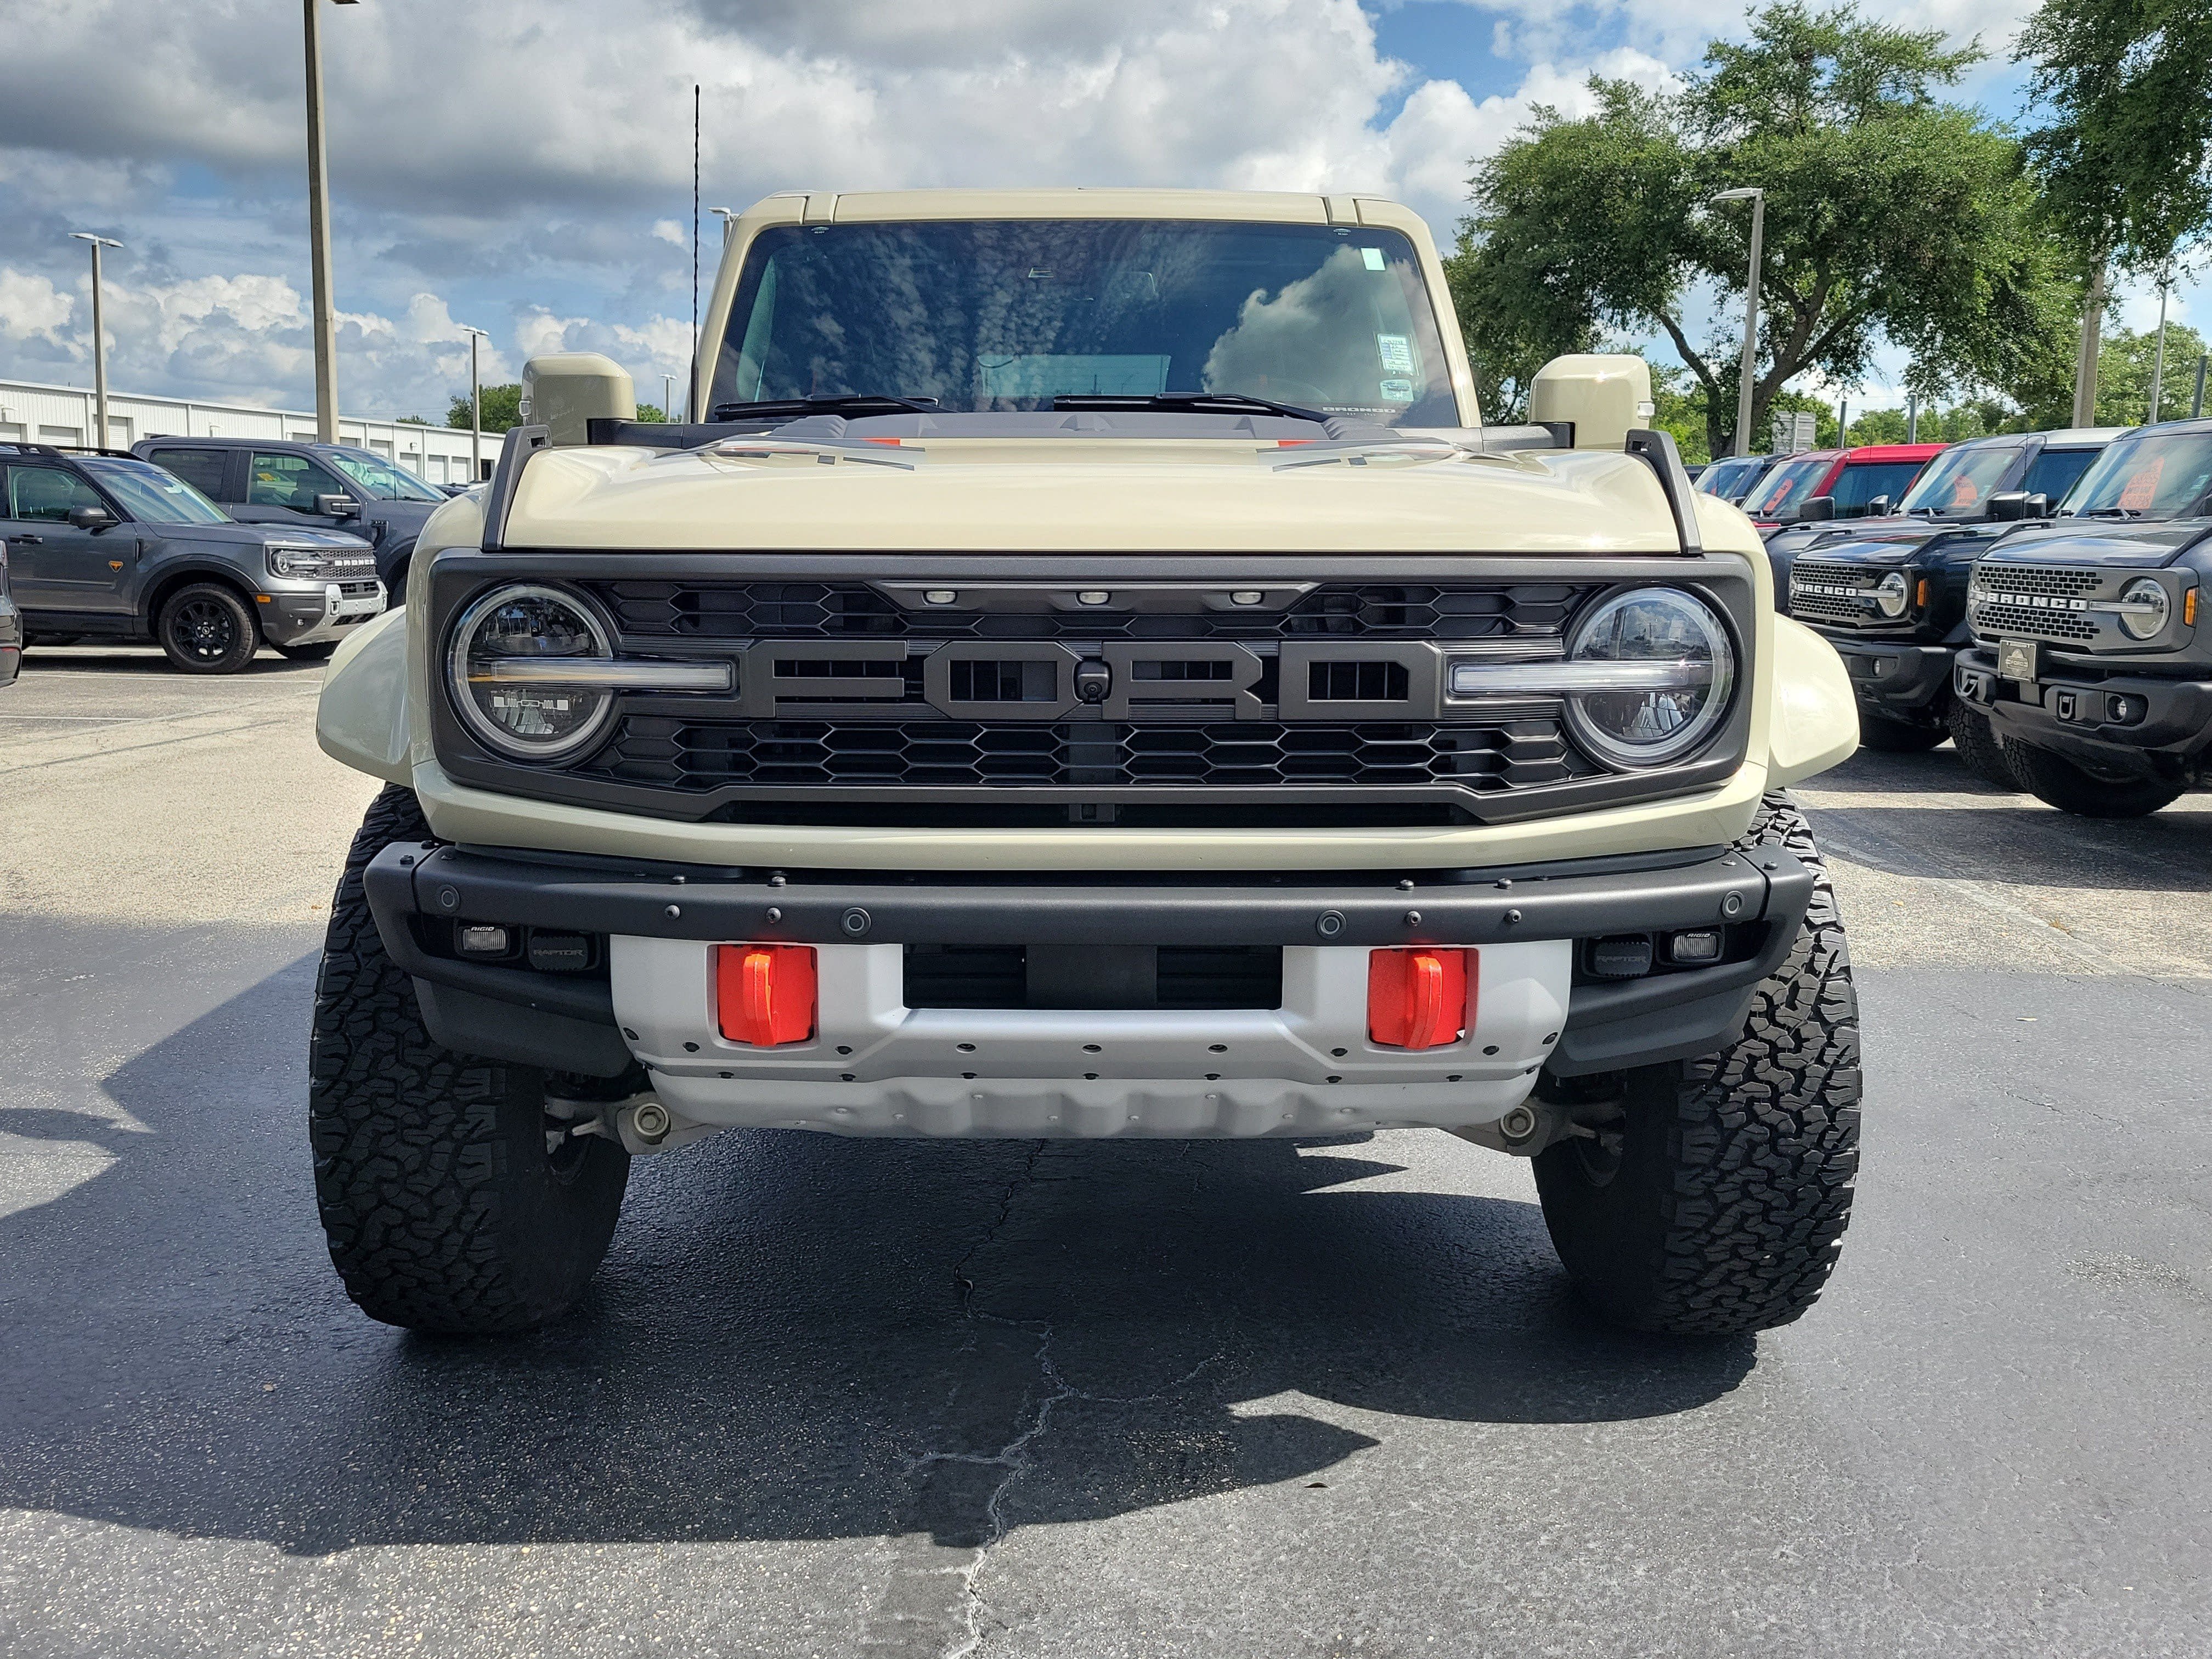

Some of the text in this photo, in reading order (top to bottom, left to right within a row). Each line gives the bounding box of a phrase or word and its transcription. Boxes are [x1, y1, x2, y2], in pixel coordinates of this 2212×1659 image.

[1797, 583, 1857, 597] BRONCO
[1987, 592, 2087, 611] BRONCO
[746, 639, 1442, 720] FORD
